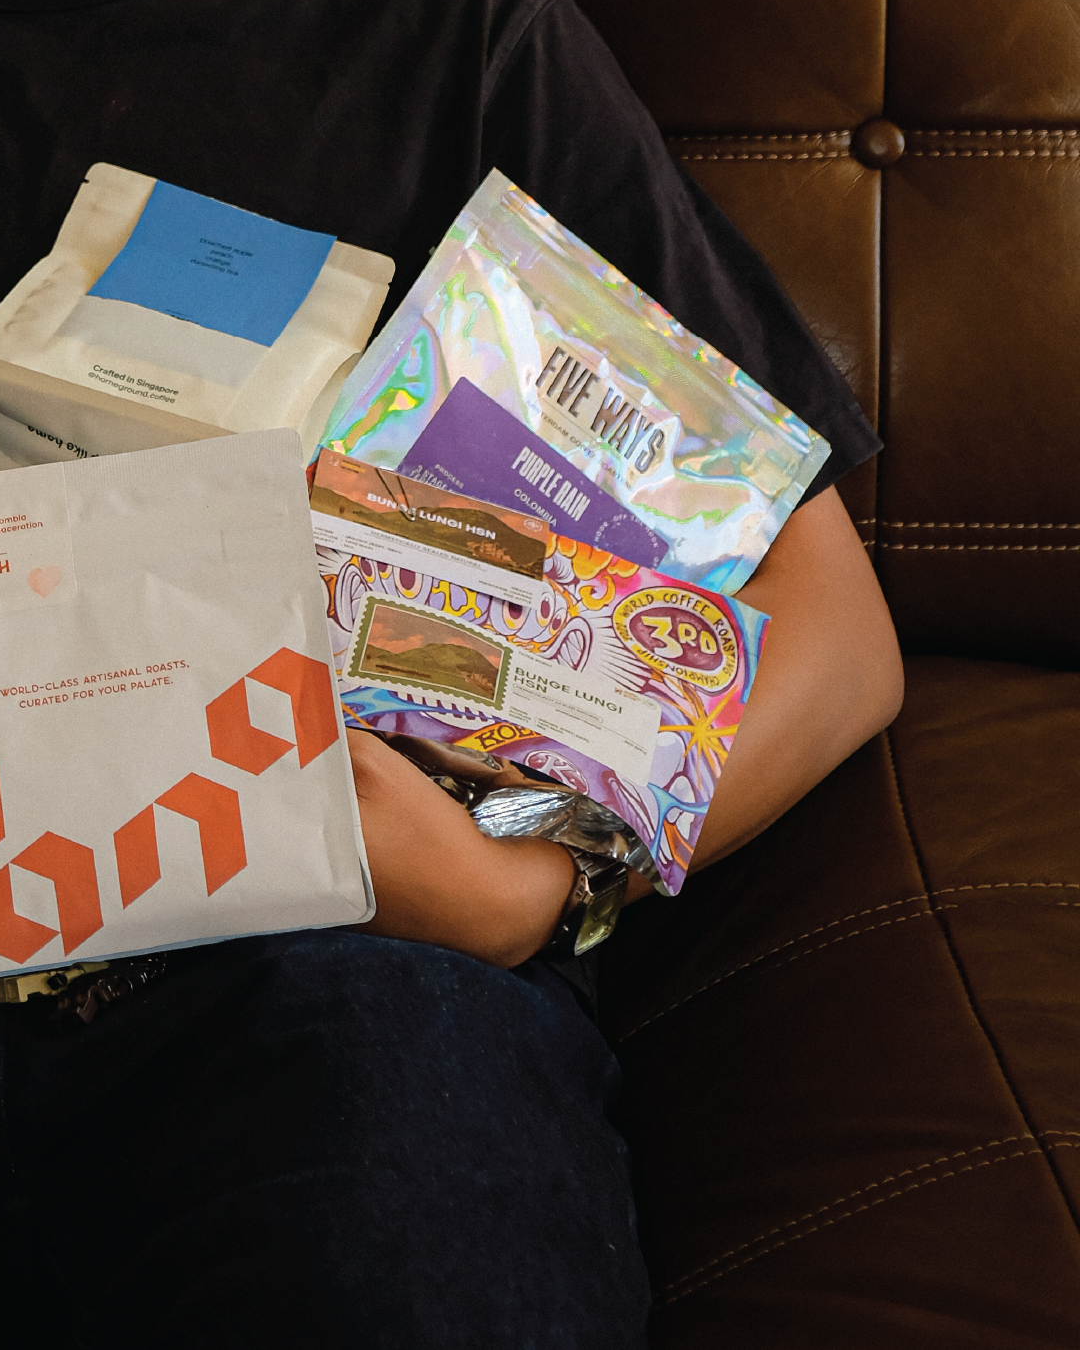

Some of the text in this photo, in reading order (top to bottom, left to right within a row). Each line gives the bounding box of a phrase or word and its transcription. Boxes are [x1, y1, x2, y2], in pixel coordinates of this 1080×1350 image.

[87, 371, 176, 404] @homeground.coffee
[93, 364, 179, 396] Crafted in Singapore
[535, 346, 601, 418] FIVE
[590, 386, 665, 475] WAYS
[510, 445, 562, 498] PURPLE
[552, 479, 591, 522] RAIN
[513, 487, 558, 528] COLOMBIA
[419, 509, 463, 530] LUNGI
[465, 523, 497, 540] HSN
[618, 594, 654, 618] WORLD
[663, 593, 711, 617] COFFEE
[641, 616, 718, 659] 3RD
[0, 678, 79, 697] WORLD-CLASS
[83, 667, 141, 685] ARTISANAL
[19, 676, 174, 708] CURATED FOR YOUR PALATE.
[513, 674, 547, 694] HSN
[515, 667, 570, 694] BUNGE
[575, 689, 623, 715] LUNGI
